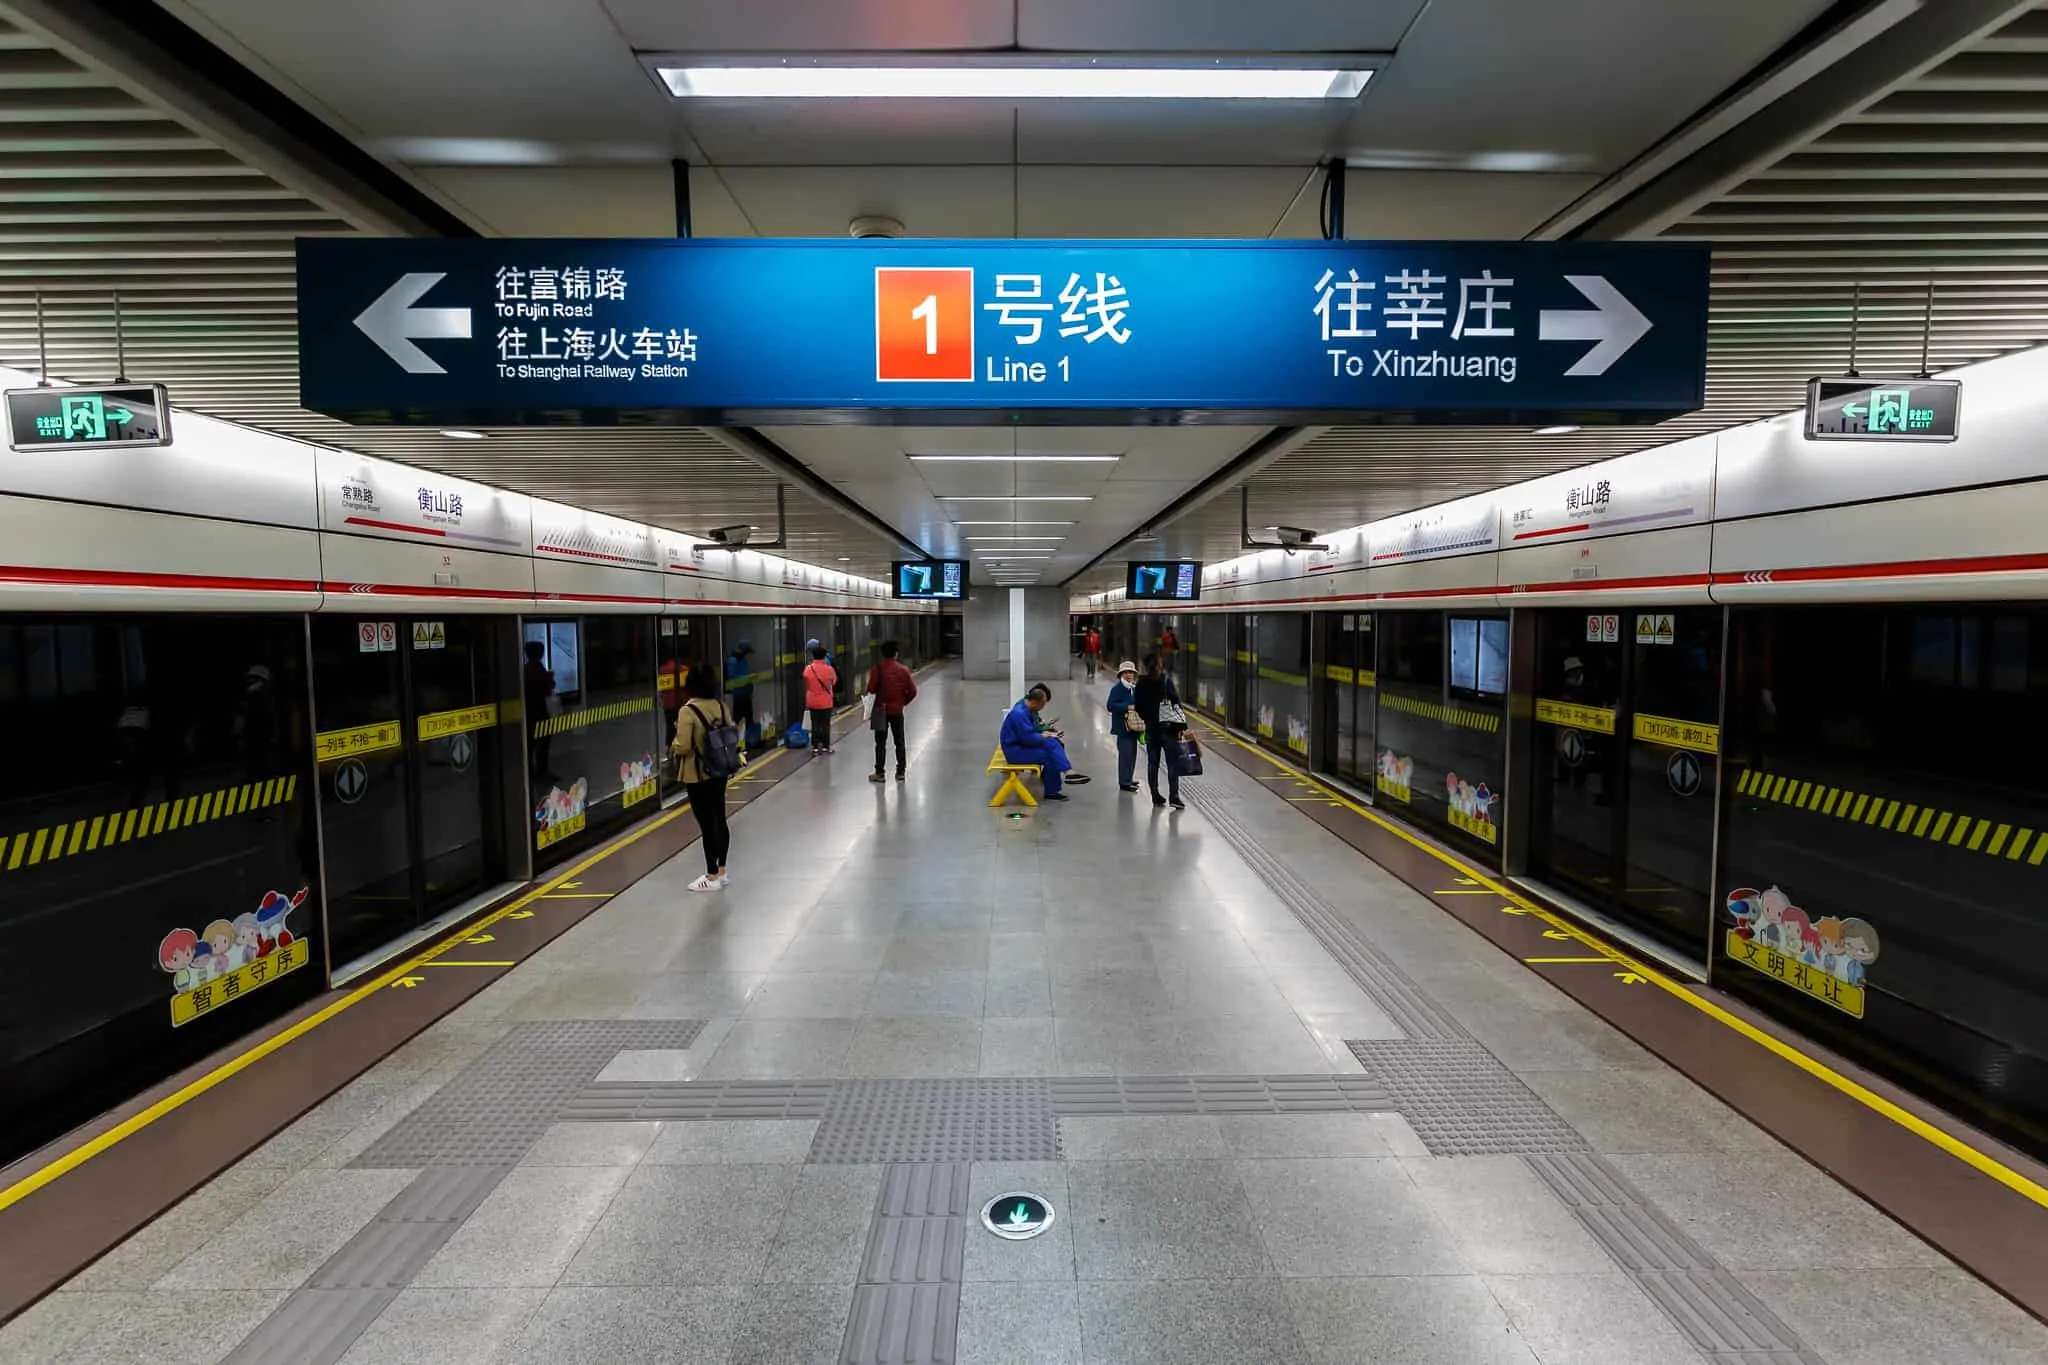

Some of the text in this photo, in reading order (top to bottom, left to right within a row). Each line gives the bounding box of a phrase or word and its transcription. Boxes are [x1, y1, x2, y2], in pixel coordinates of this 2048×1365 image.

[495, 266, 628, 301] 往富锦路
[495, 304, 592, 320] To Fujin Road
[911, 271, 1132, 356] 1 号线
[1313, 268, 1515, 341] 往莘庄
[497, 326, 698, 361] 往上海火车站
[497, 364, 688, 381] To Shanghai Railway Station
[986, 355, 1070, 382] Line 1
[1327, 349, 1517, 382] To Xinzhuang
[417, 487, 463, 517] 衡山路
[1566, 479, 1611, 511] 衡山路
[192, 949, 293, 1012] 智者守序
[1743, 942, 1843, 1005] 文明礼让
